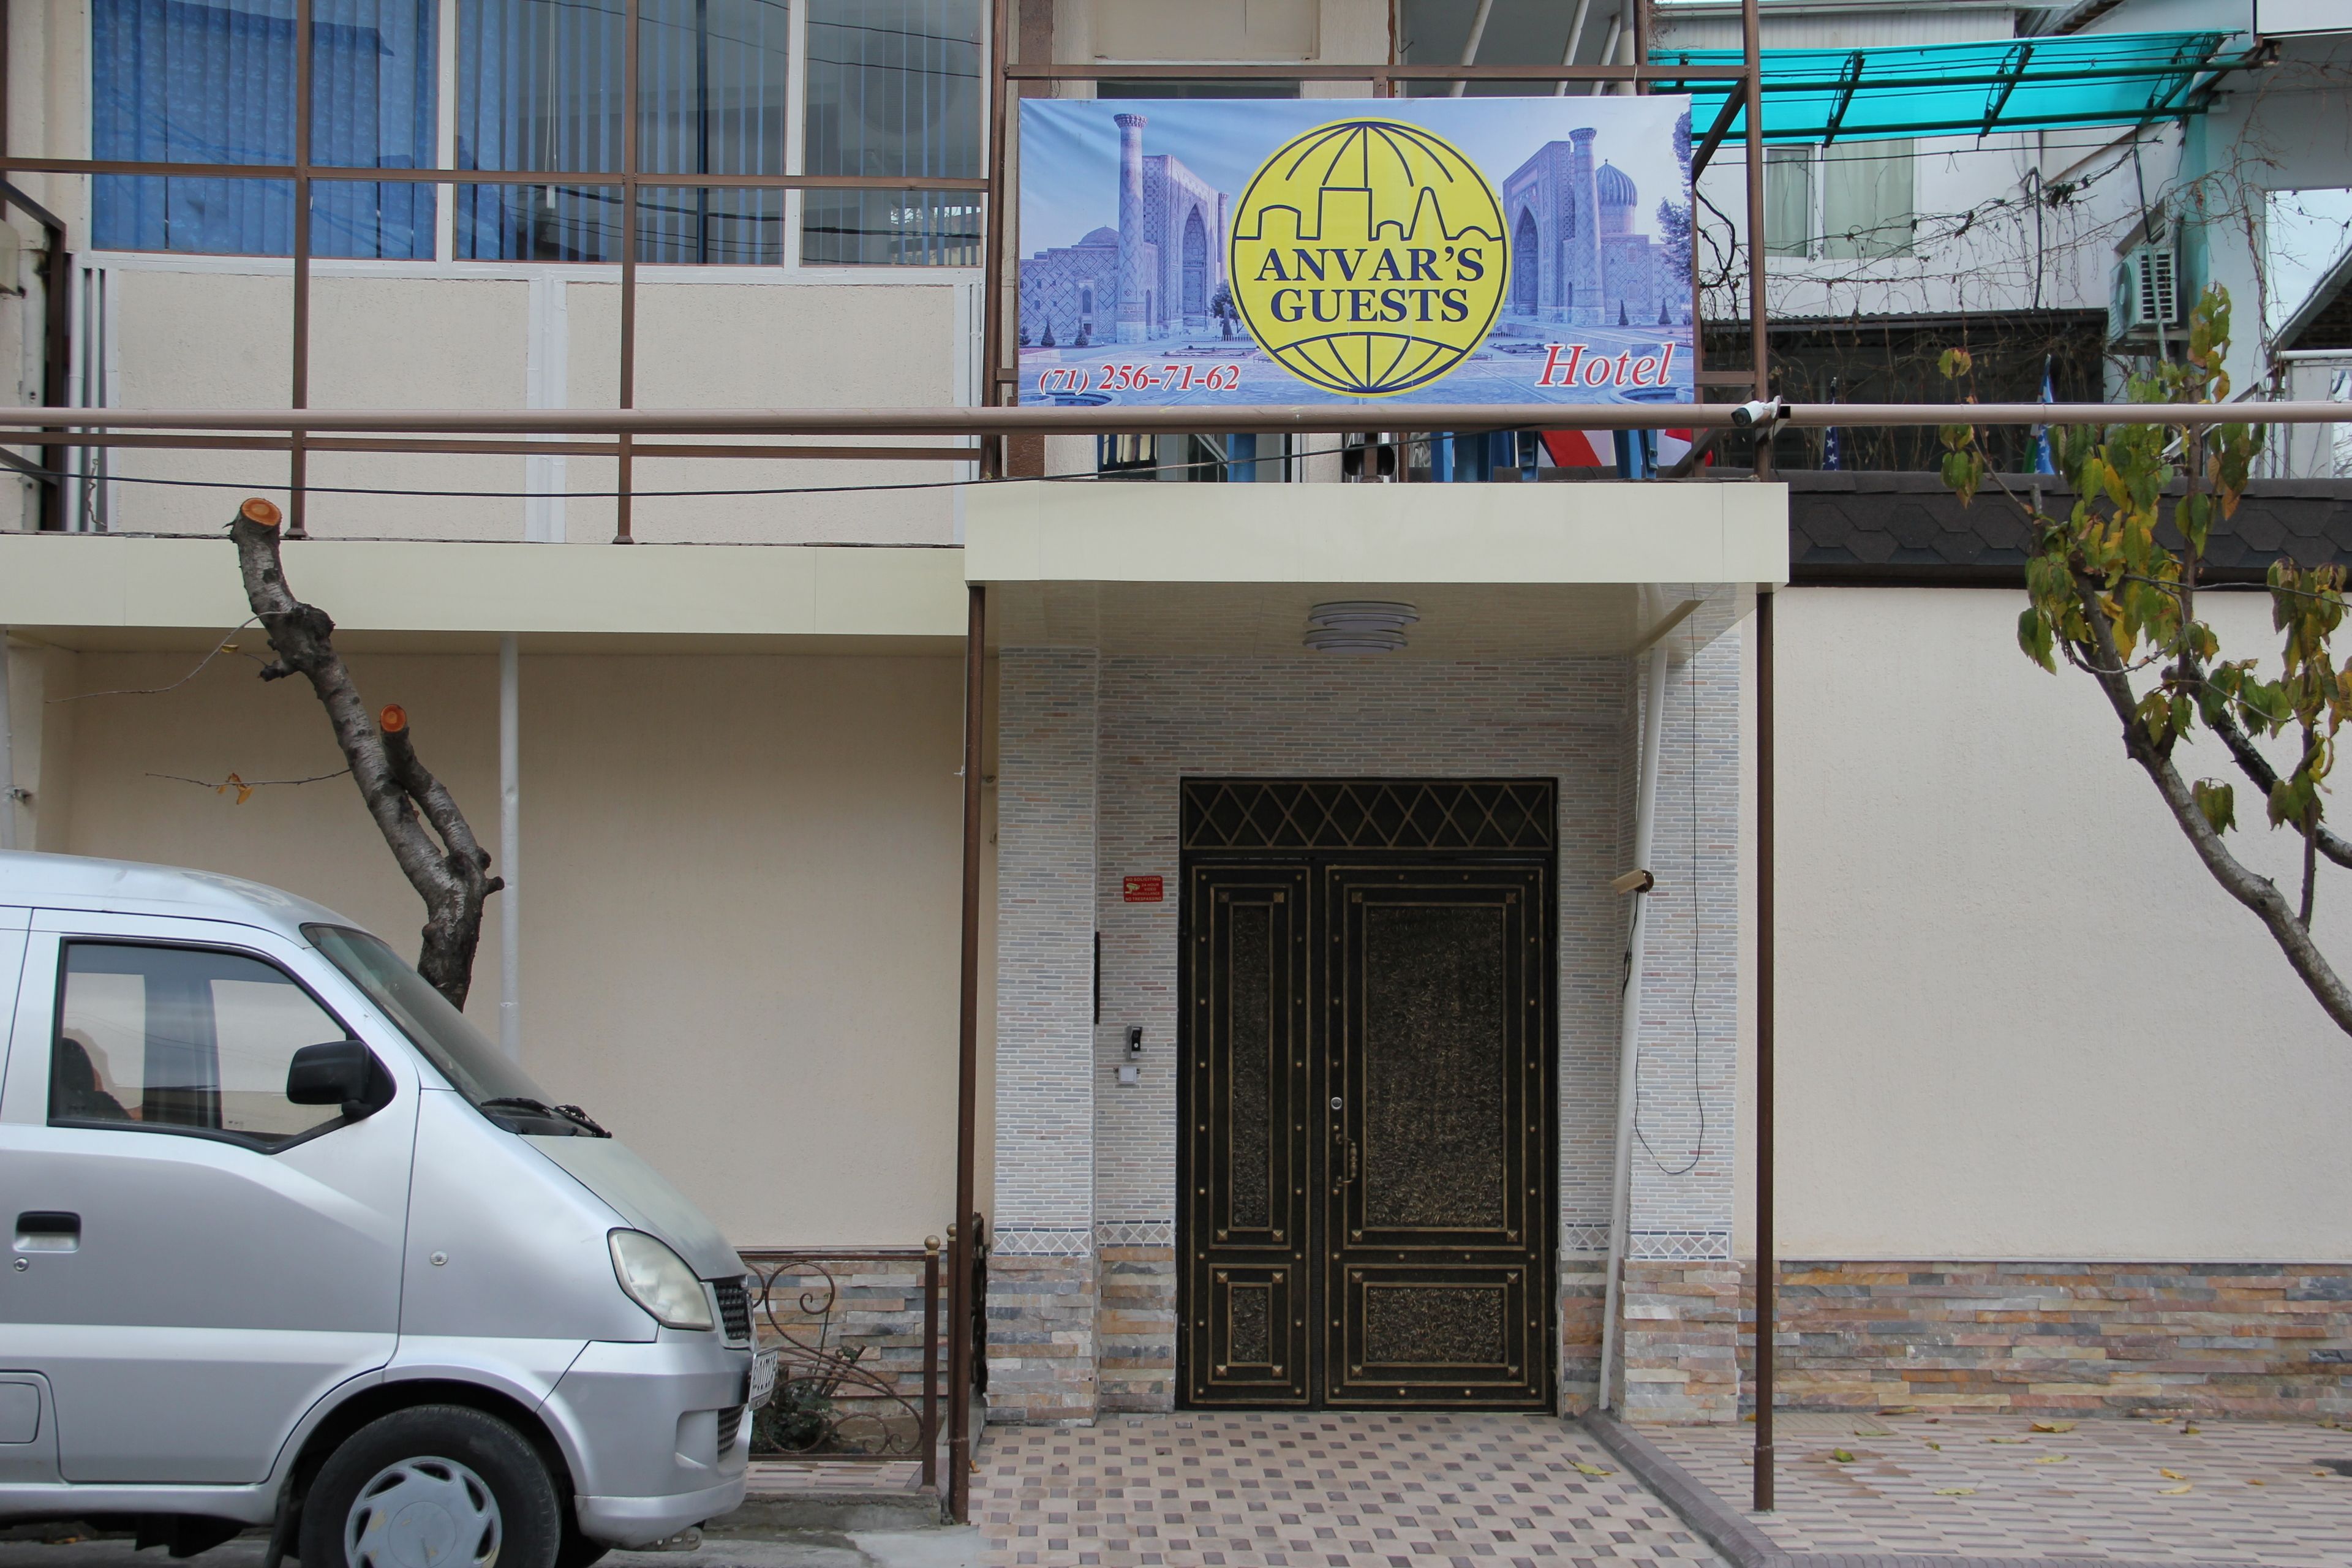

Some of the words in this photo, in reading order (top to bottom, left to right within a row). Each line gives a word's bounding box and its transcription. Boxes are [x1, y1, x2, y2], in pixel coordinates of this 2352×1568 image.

[1253, 246, 1484, 282] ANVAR'S
[1270, 288, 1469, 322] GUESTS
[1039, 369, 1089, 394] (71)
[1098, 364, 1240, 391] 256-71-62
[1534, 341, 1675, 387] Hotel
